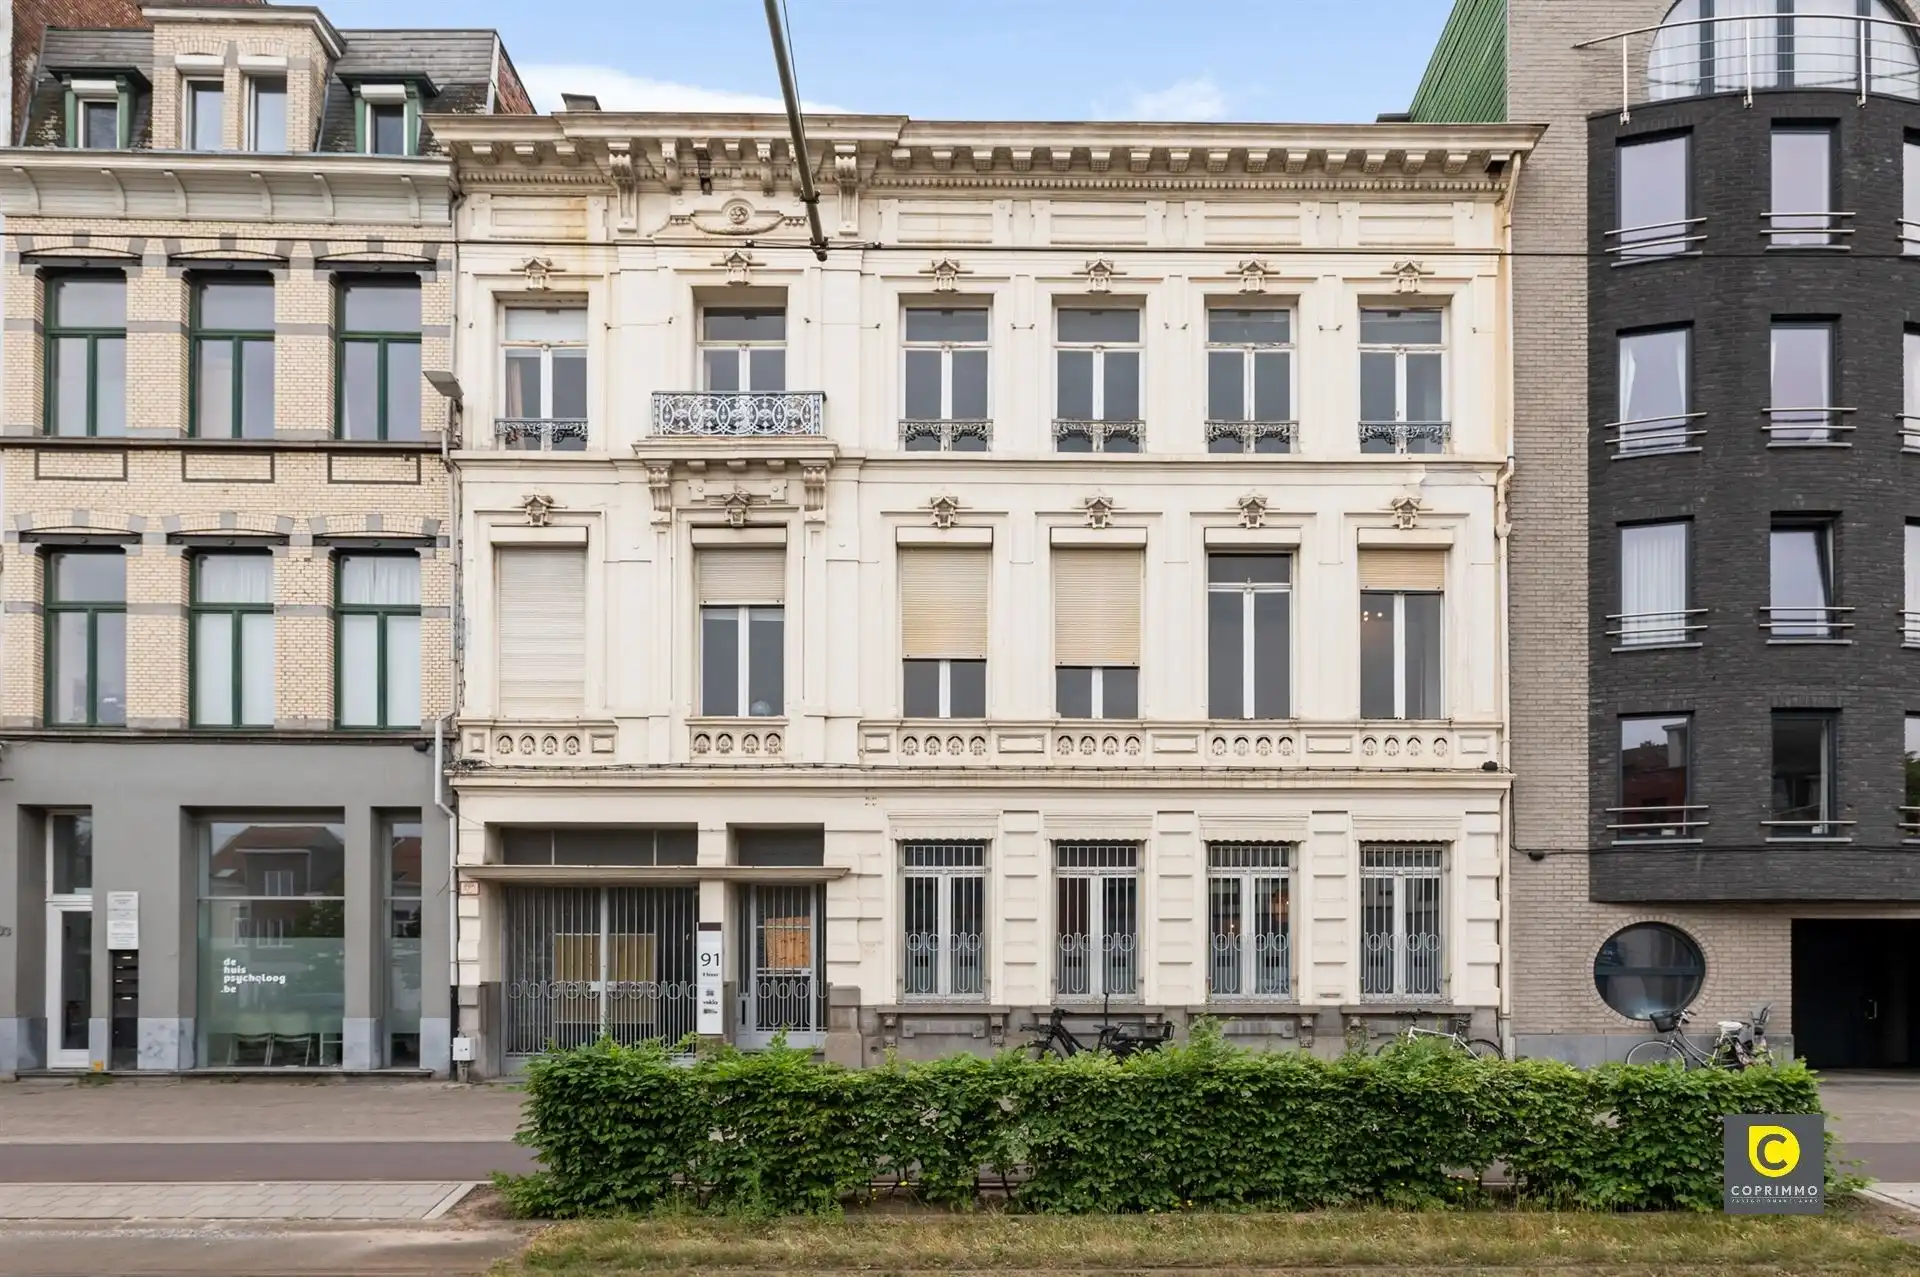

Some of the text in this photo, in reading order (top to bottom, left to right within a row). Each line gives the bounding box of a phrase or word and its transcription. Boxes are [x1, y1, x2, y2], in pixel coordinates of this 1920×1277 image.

[223, 957, 237, 966] de
[701, 952, 720, 967] 91
[223, 965, 247, 974] huis
[223, 974, 286, 984] psycholoog
[220, 985, 237, 993] .be
